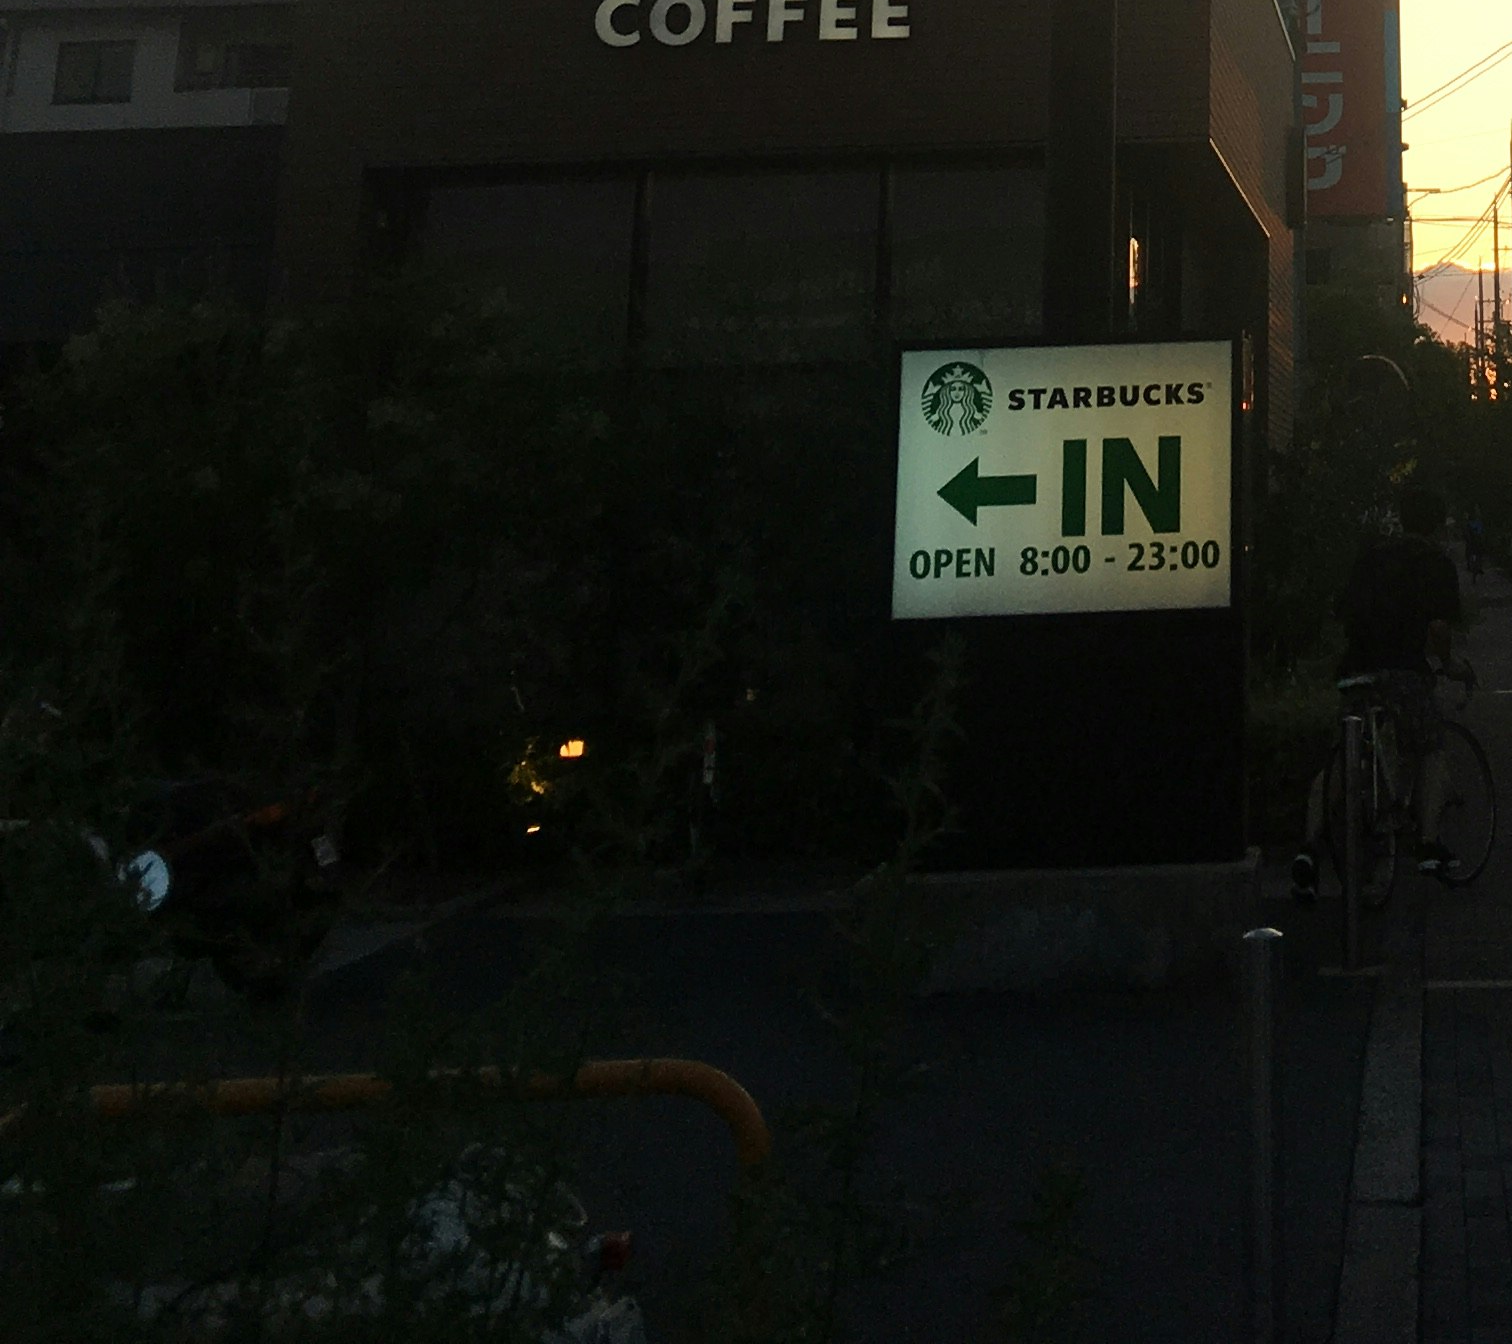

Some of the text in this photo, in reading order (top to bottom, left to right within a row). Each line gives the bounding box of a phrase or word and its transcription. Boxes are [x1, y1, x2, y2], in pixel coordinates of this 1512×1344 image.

[1007, 382, 1205, 411] STARBUCKS
[1061, 435, 1181, 537] IN
[909, 547, 996, 580] OPEN
[1019, 544, 1092, 576] 8:00
[1126, 539, 1221, 572] 23:00
